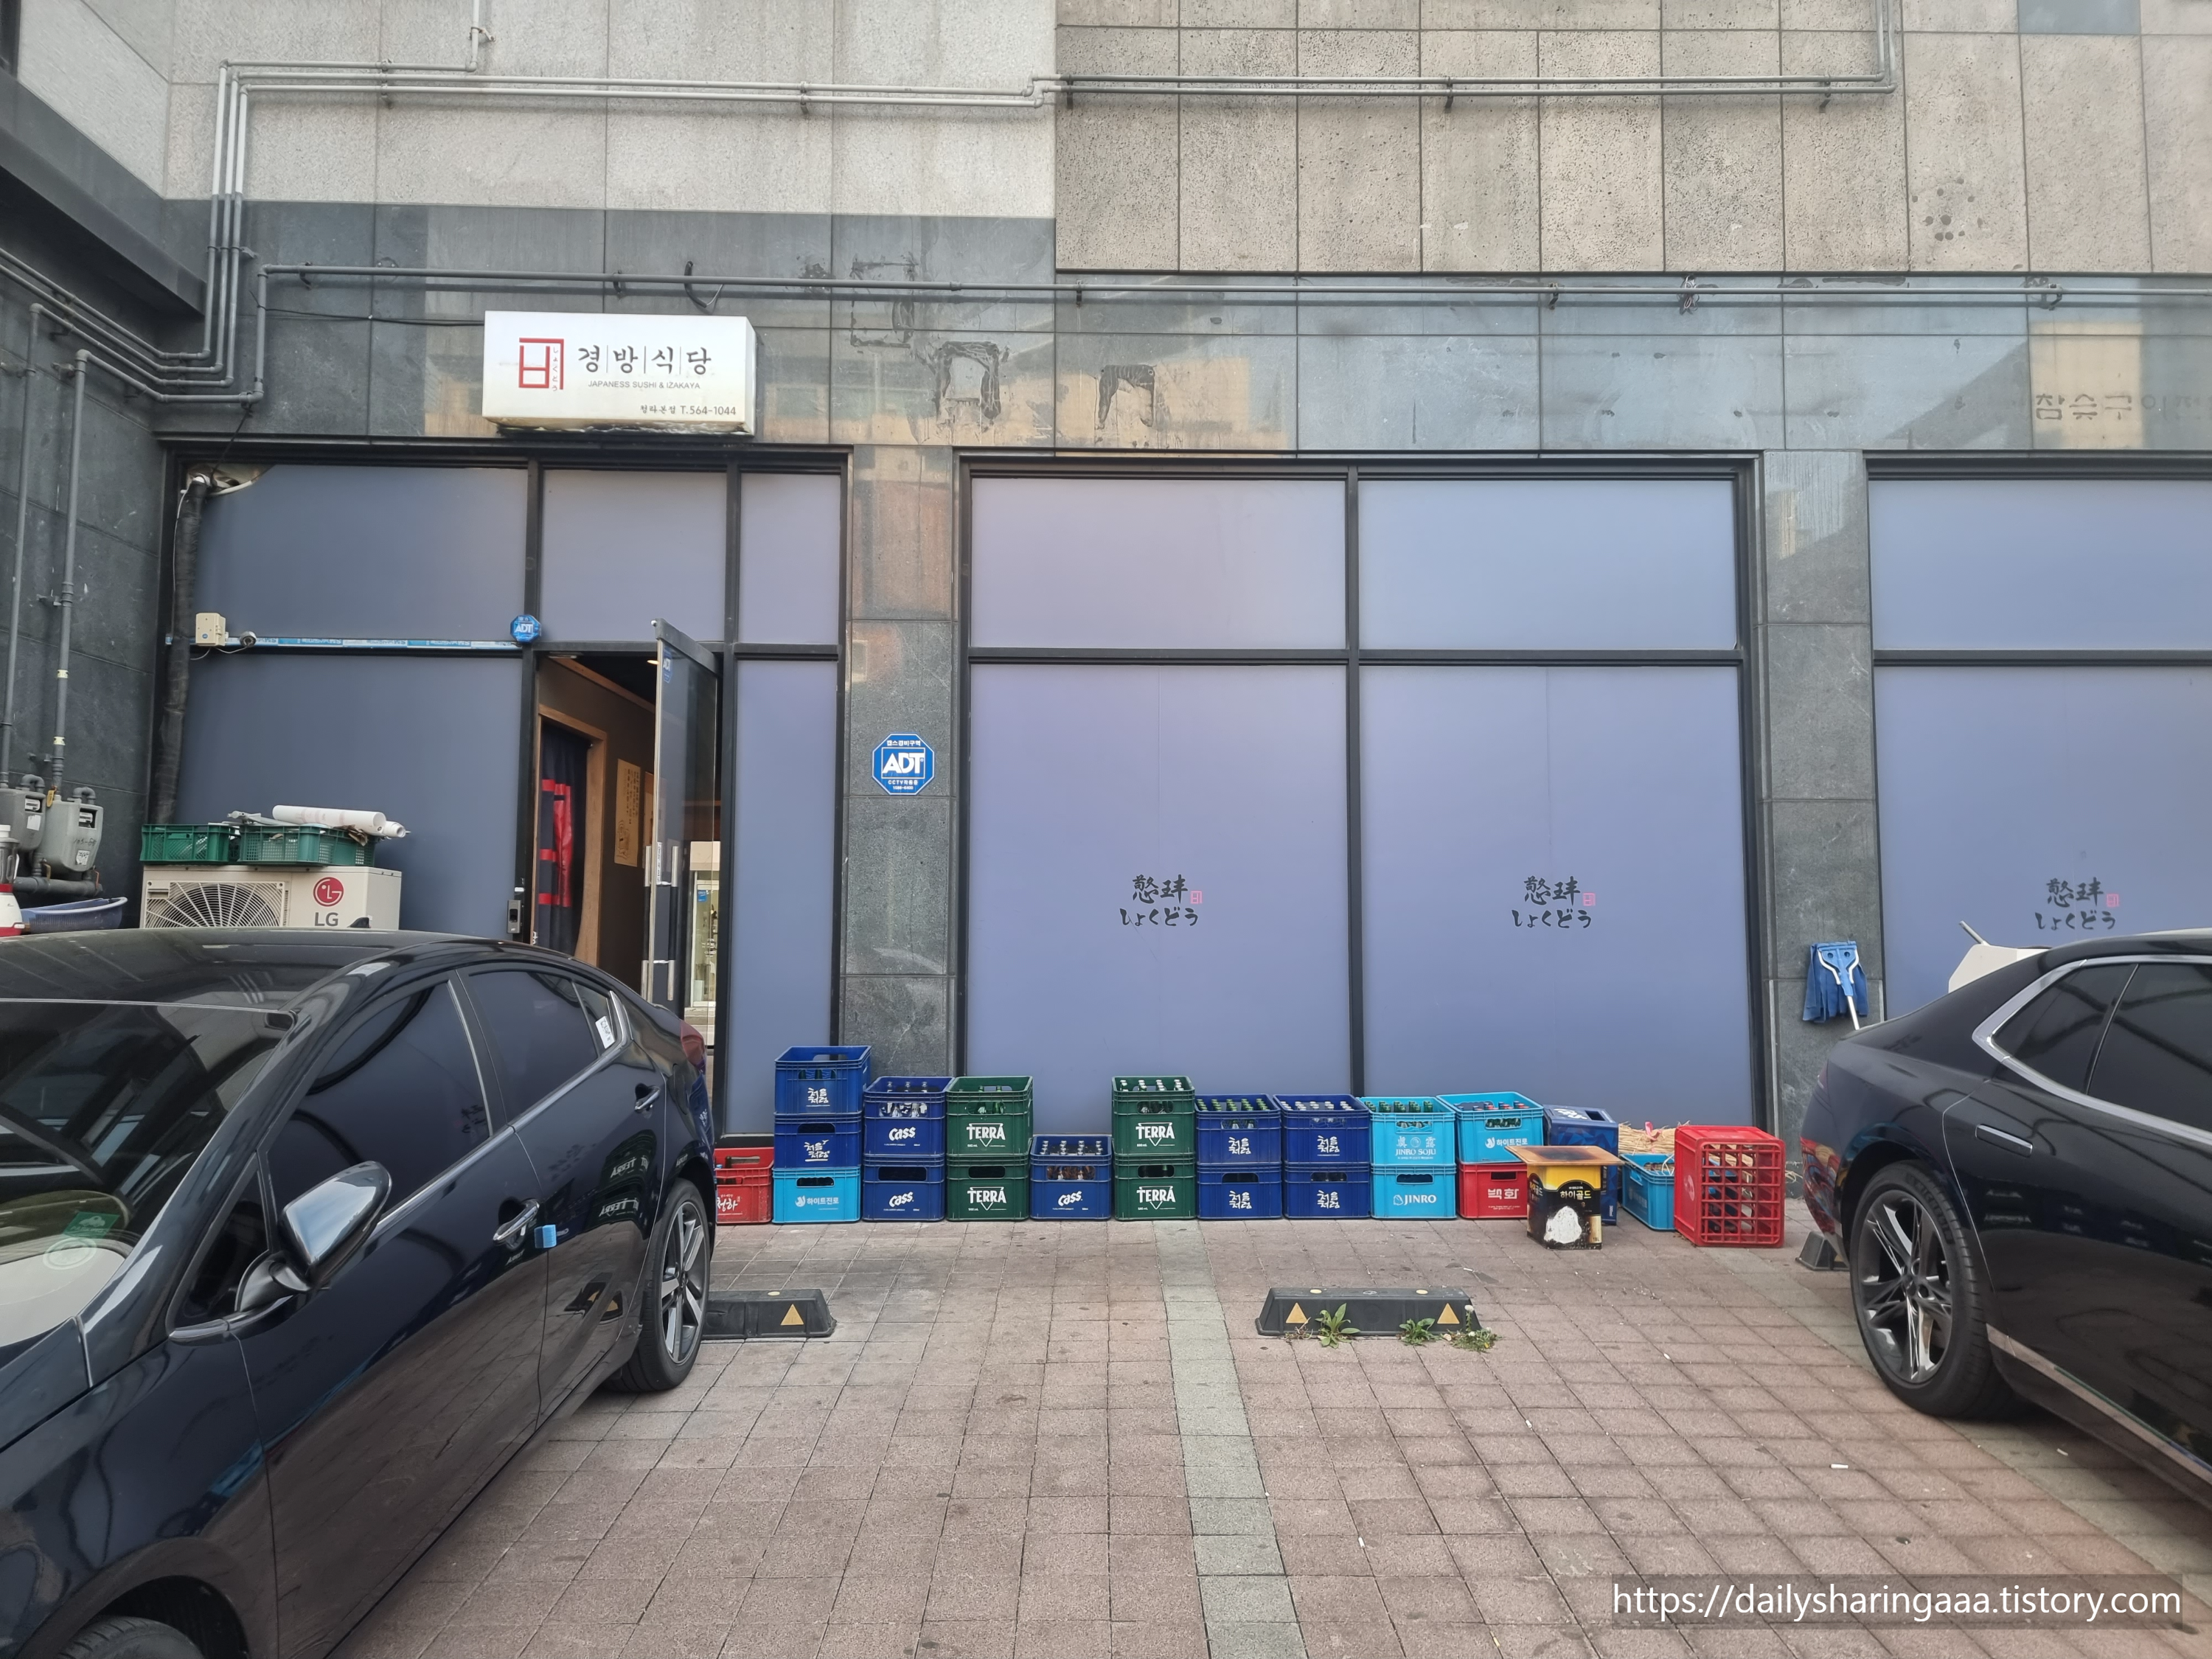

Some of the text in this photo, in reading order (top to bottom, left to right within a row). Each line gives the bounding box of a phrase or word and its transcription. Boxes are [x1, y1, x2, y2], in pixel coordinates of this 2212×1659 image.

[680, 405, 736, 415] T.564-1044
[515, 623, 533, 633] ADT
[883, 752, 924, 773] ADT
[314, 911, 338, 927] LG
[1119, 906, 1198, 926] しょくどう
[1512, 908, 1592, 929] しょくどう
[2034, 910, 2116, 931] しょくどう
[966, 1126, 1006, 1140] TERRA
[1135, 1125, 1175, 1139] TERRA
[1496, 1138, 1528, 1146] 하이트진로
[1395, 1148, 1416, 1156] JINRO
[807, 1197, 839, 1205] 하이트진로
[967, 1189, 1006, 1203] TERRA
[1136, 1189, 1176, 1203] TERRA
[1404, 1194, 1437, 1206] JINRO
[1559, 1190, 1591, 1200] 하이골드
